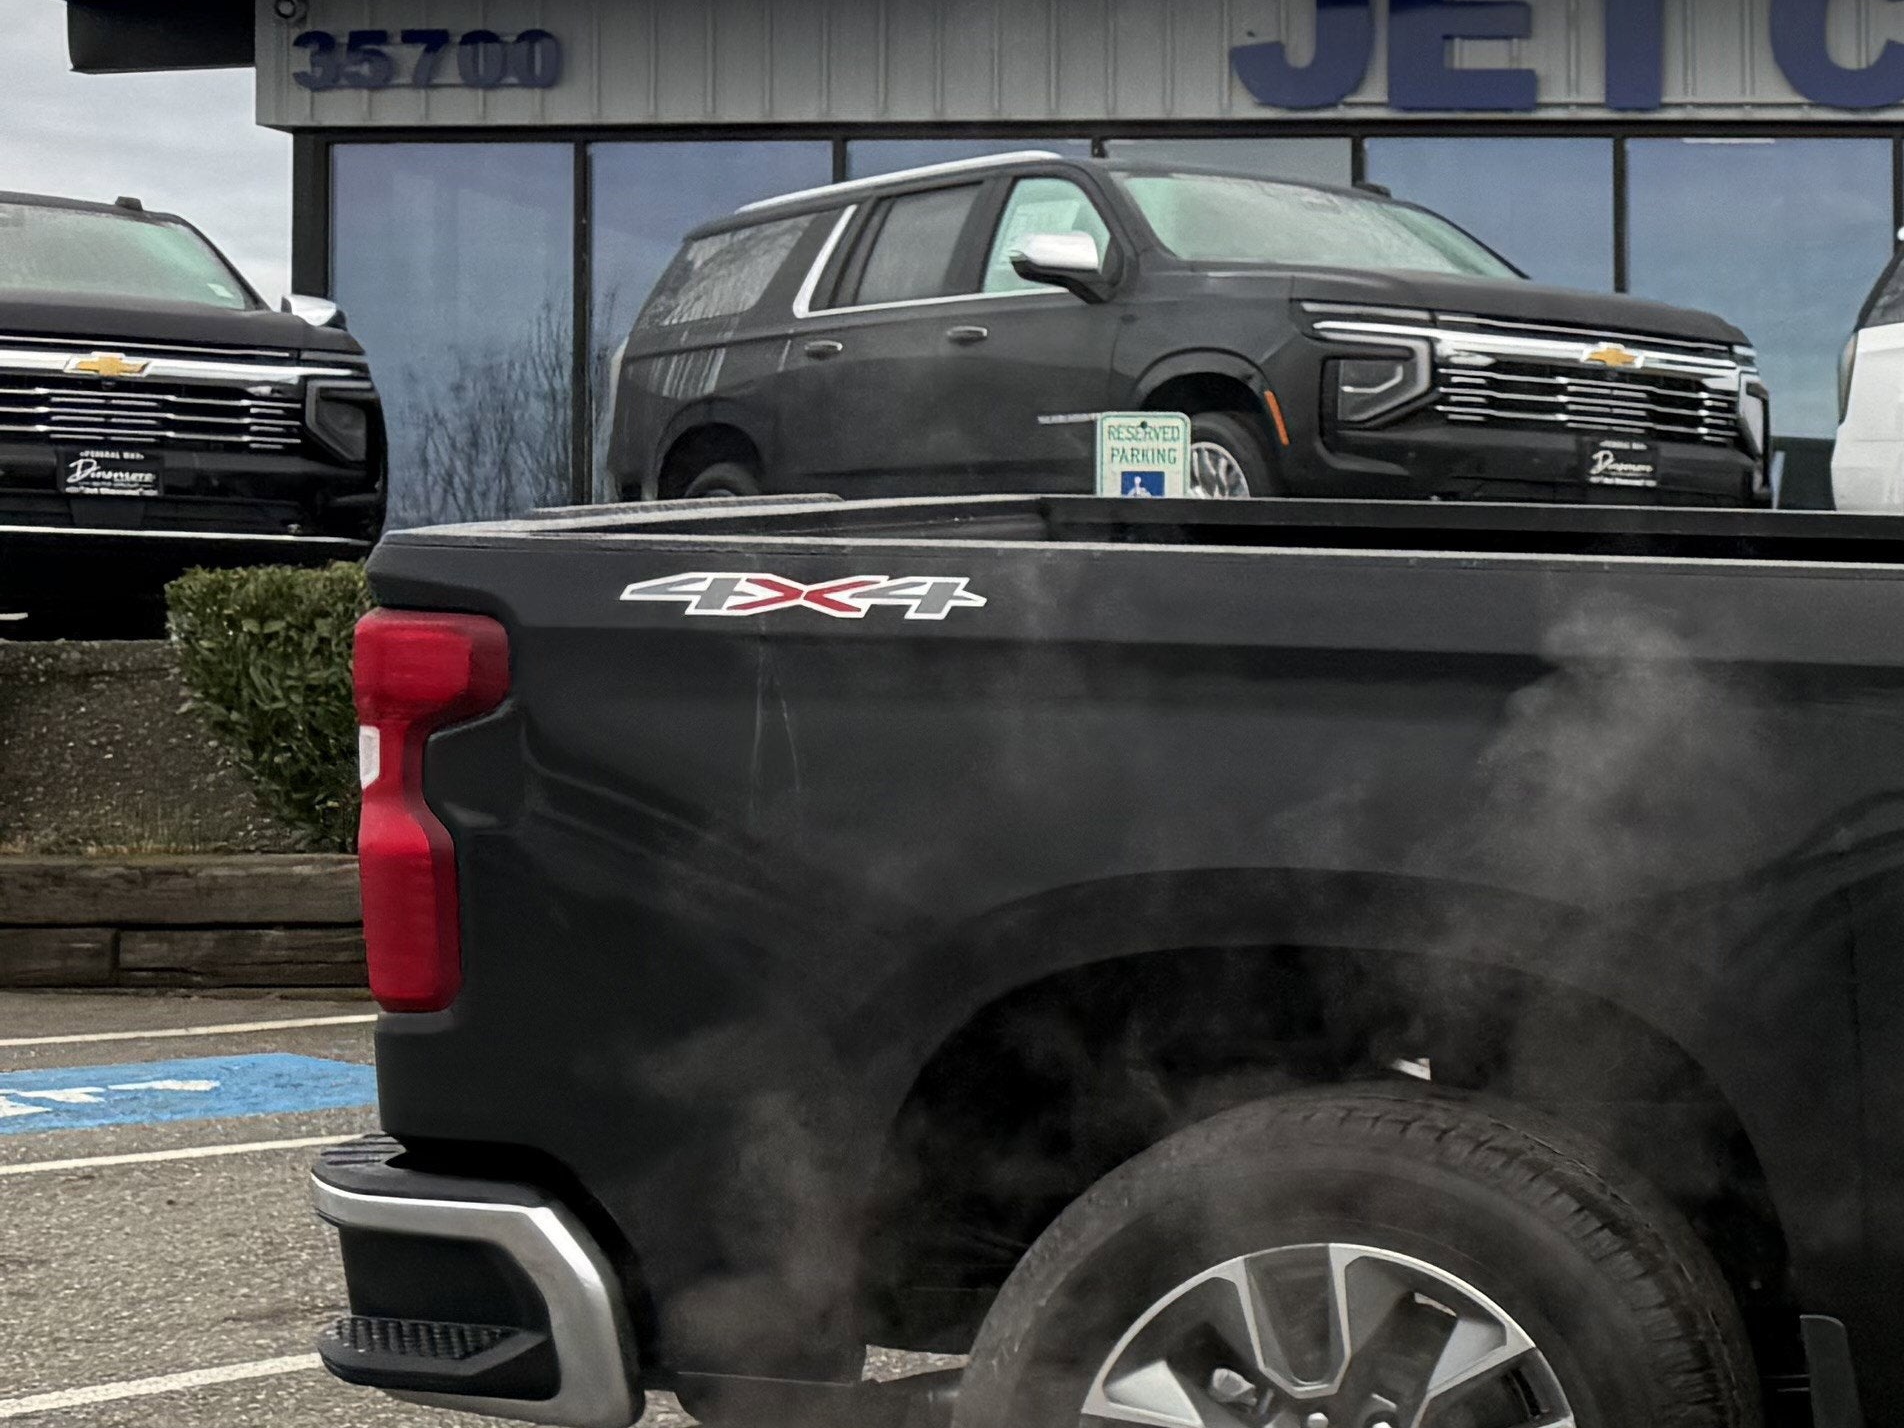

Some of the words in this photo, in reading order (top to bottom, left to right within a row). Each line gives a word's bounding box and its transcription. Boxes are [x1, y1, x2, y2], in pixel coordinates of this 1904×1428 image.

[292, 28, 562, 91] 35700
[1108, 424, 1180, 442] RESERVED
[1111, 445, 1177, 465] PARKING
[619, 571, 988, 620] 4X4
